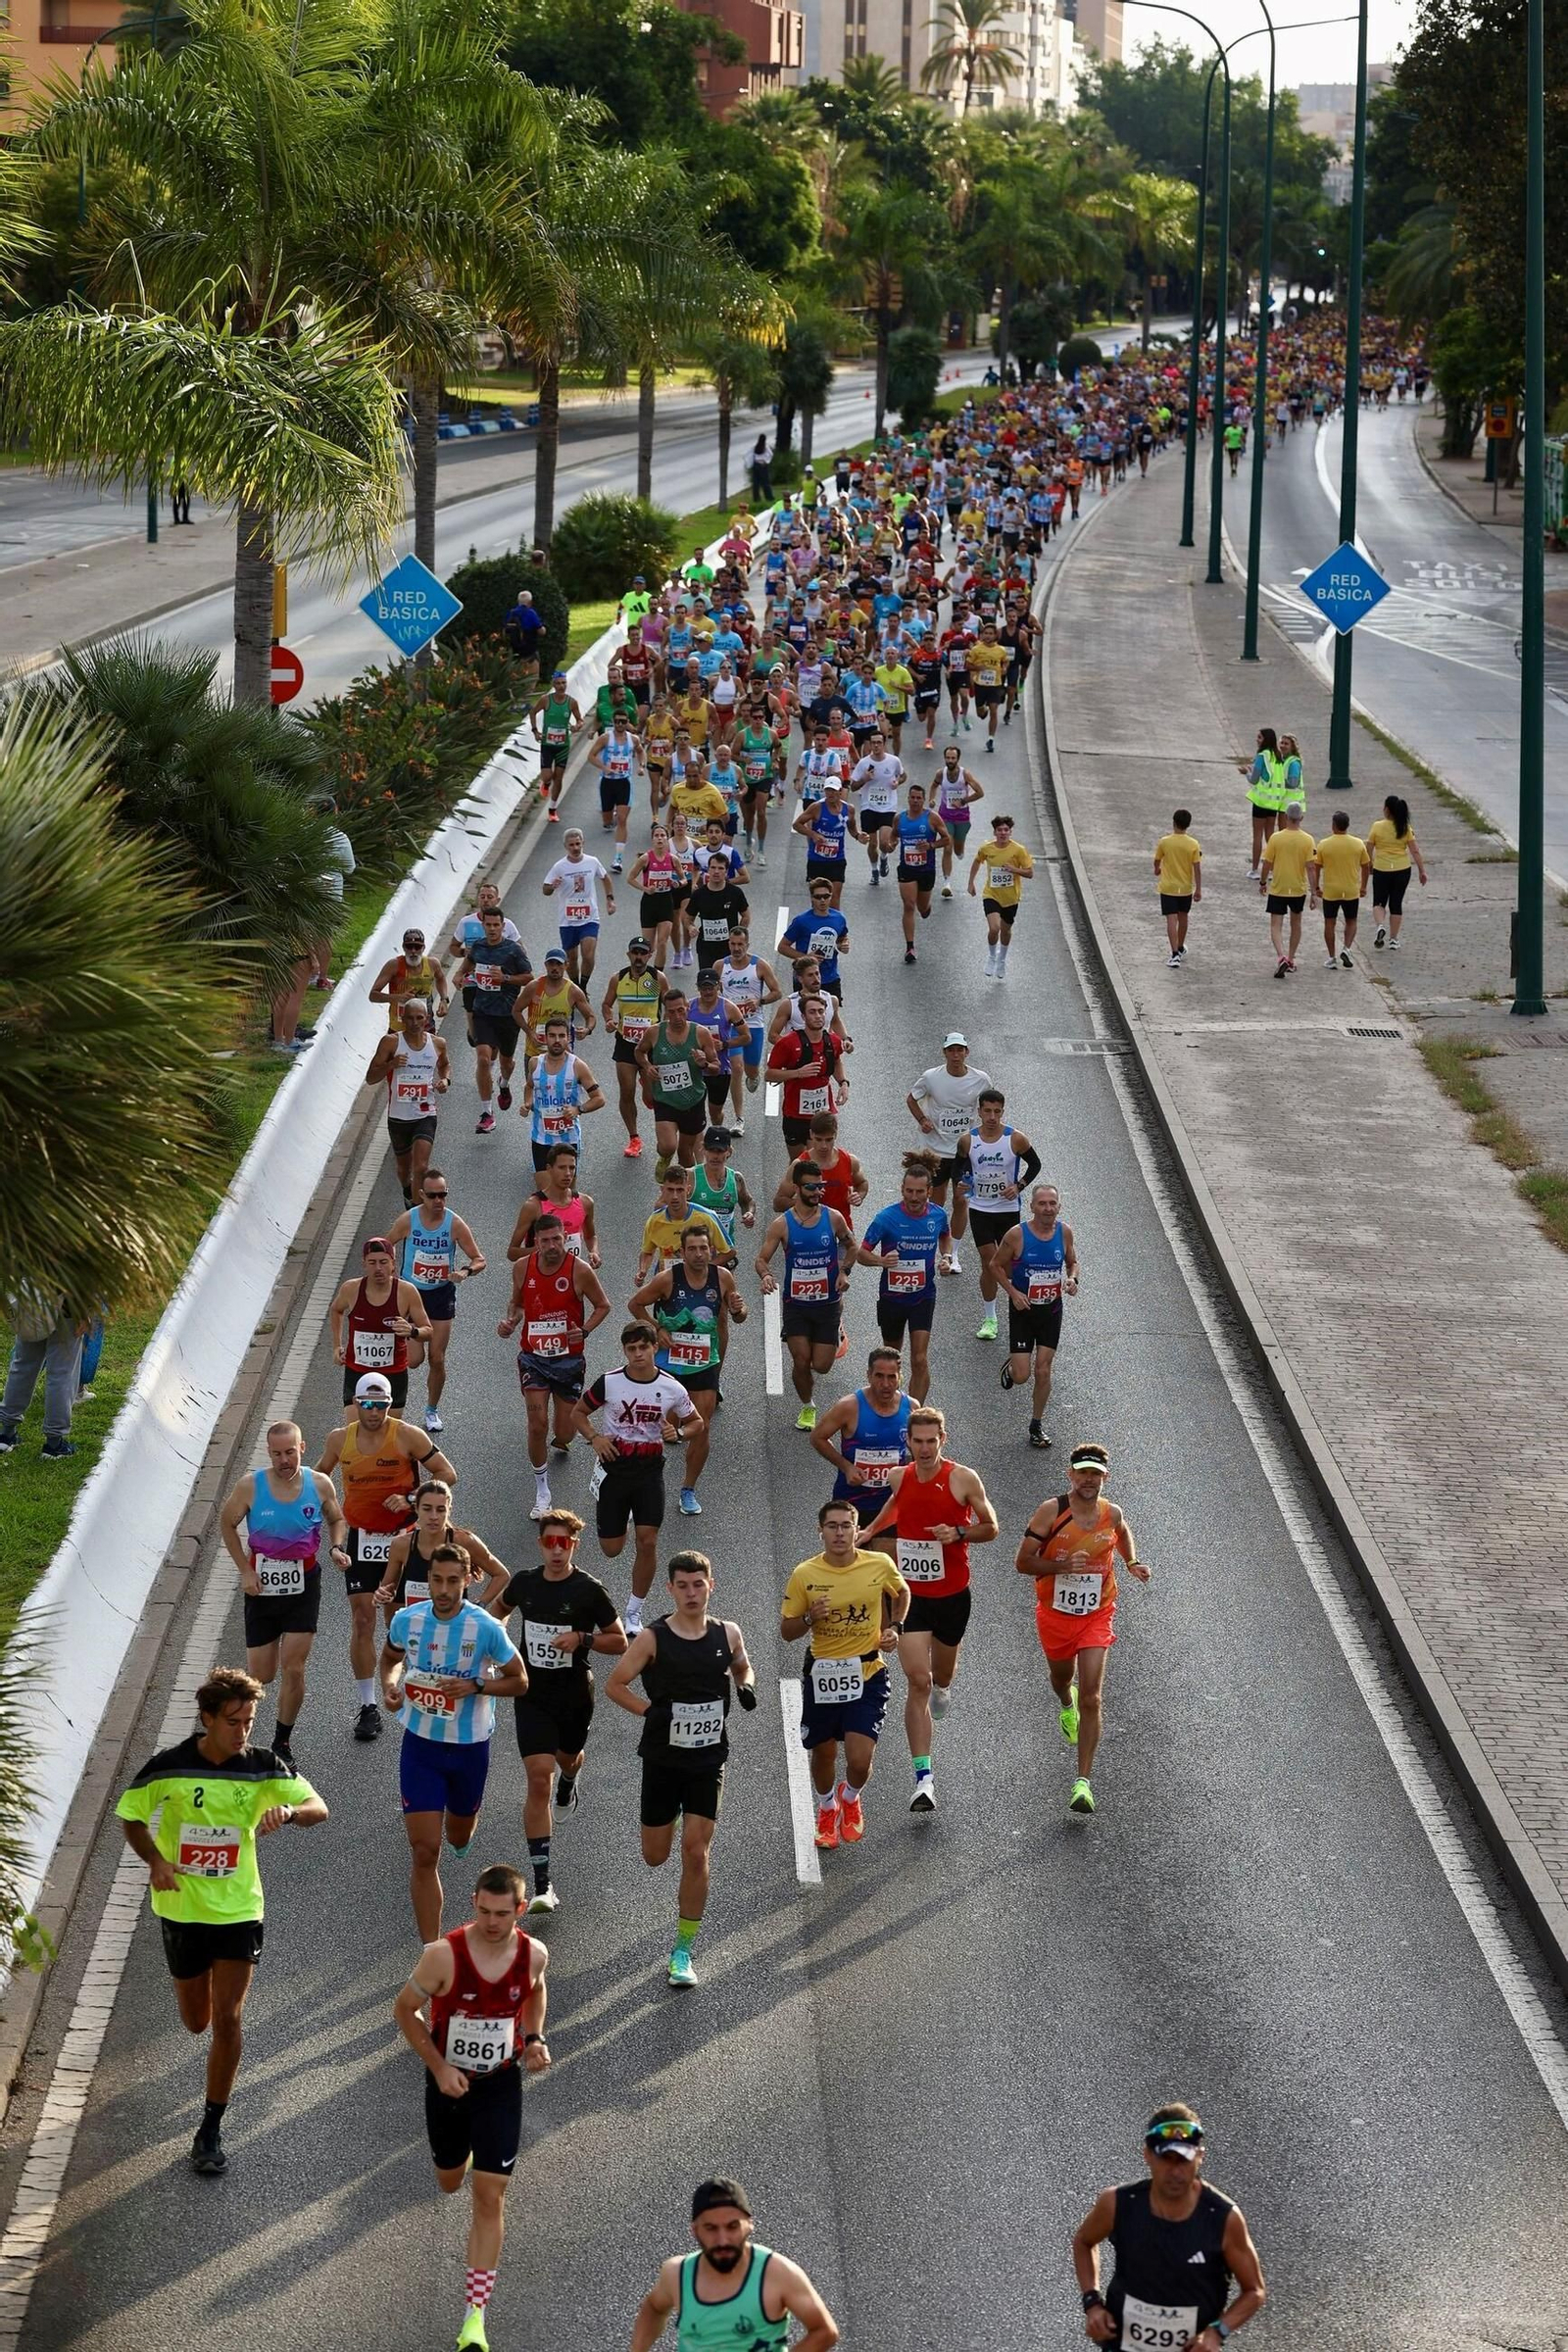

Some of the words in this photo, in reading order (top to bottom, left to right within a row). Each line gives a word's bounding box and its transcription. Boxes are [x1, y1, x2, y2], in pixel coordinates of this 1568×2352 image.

[1403, 561, 1508, 570] TAXI
[1330, 574, 1361, 587] RED
[1404, 579, 1523, 589] SOLO
[394, 592, 426, 604] RED
[1316, 588, 1373, 602] BASICA
[379, 608, 440, 619] BASICA
[992, 874, 1012, 883] 8852
[704, 926, 728, 936] 10646
[662, 1071, 690, 1085] 5073
[403, 1087, 422, 1098] 291
[803, 1098, 827, 1109] 2161
[941, 1116, 970, 1128] 10643
[977, 1182, 1006, 1194] 7796
[413, 1237, 449, 1250] nerja
[418, 1266, 443, 1280] 264
[895, 1275, 919, 1287] 225
[798, 1284, 822, 1296] 222
[1036, 1287, 1057, 1299] 135
[536, 1336, 562, 1350] 149
[356, 1346, 394, 1358] 11067
[677, 1347, 703, 1360] 115
[902, 1556, 942, 1574] 2006
[260, 1570, 301, 1586] 8680
[1058, 1590, 1098, 1607] 1813
[818, 1675, 860, 1692] 6055
[413, 1689, 447, 1709] 209
[673, 1720, 721, 1735] 11282
[190, 1849, 229, 1868] 228
[454, 2038, 506, 2060] 8861
[1130, 2323, 1189, 2348] 6293
